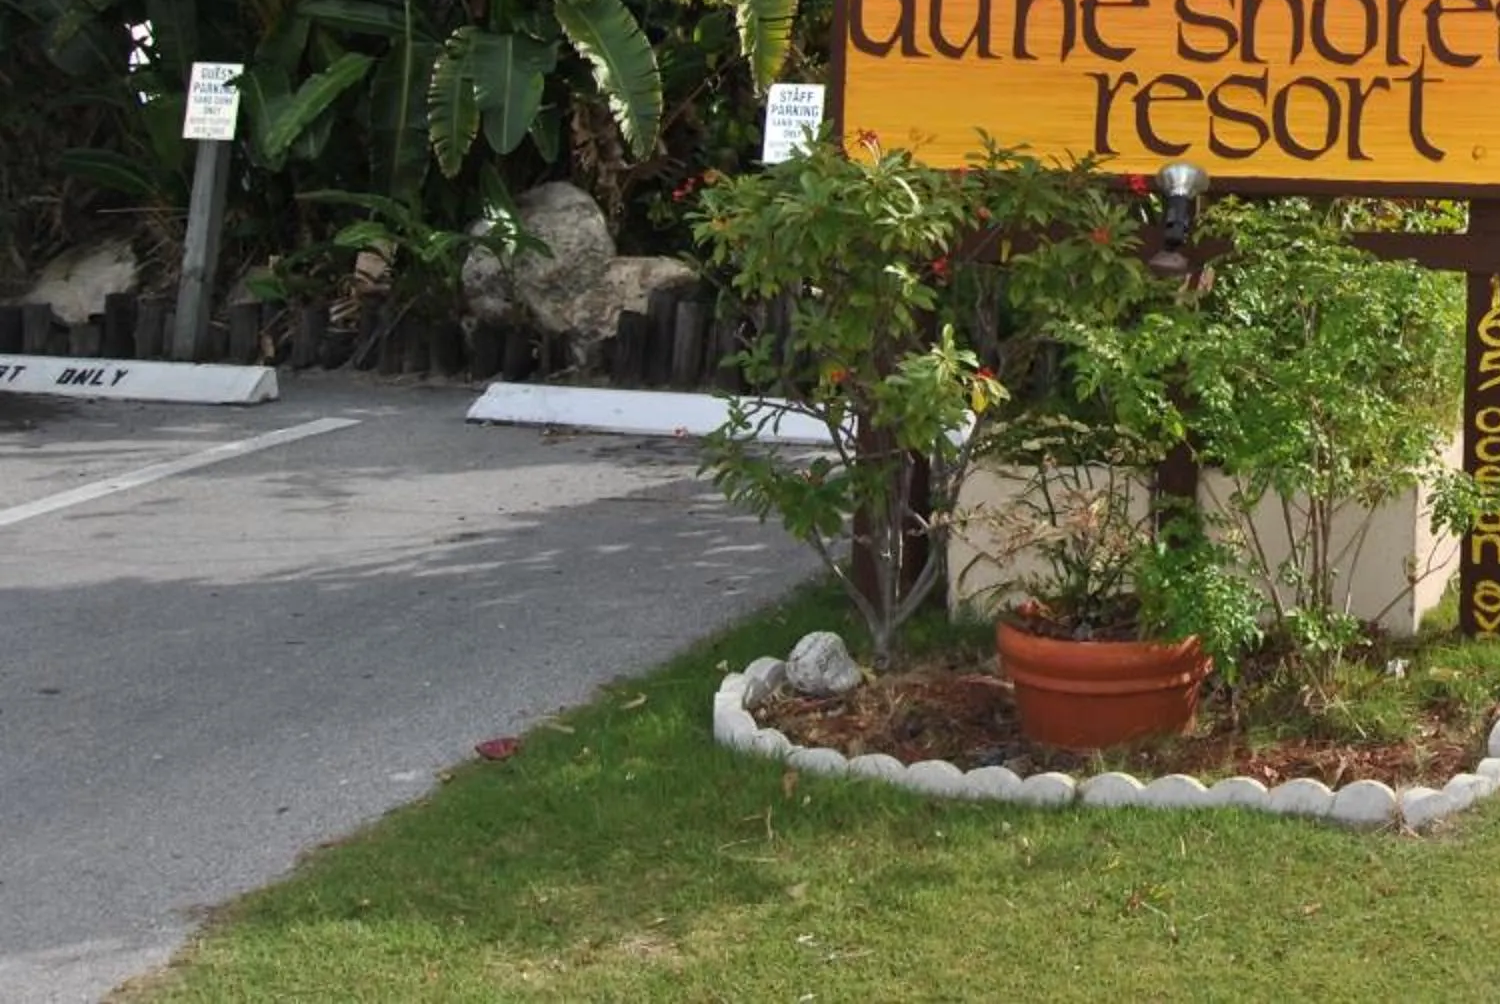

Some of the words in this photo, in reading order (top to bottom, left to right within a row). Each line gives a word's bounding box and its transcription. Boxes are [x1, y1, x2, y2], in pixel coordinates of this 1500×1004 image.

[780, 90, 815, 102] STAFF
[1088, 46, 1447, 163] resort
[770, 103, 819, 116] PARKING
[56, 366, 130, 387] ONLY
